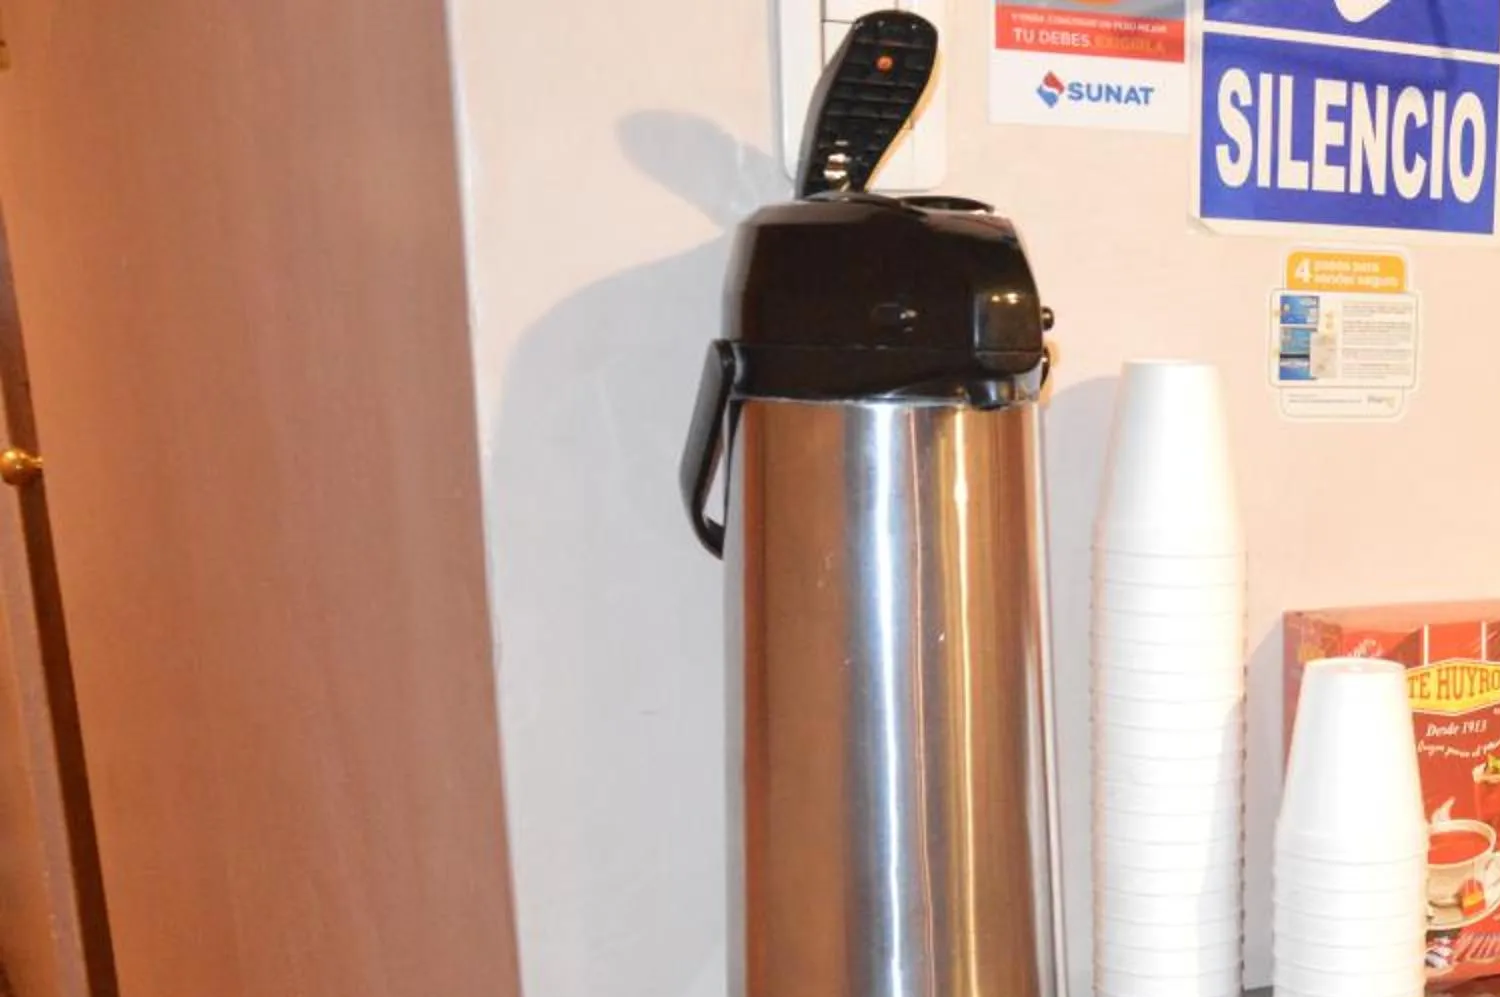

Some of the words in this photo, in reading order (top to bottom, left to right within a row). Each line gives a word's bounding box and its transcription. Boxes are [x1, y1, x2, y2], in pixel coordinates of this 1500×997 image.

[1038, 30, 1091, 48] DEBES
[1067, 81, 1155, 105] SUNAT
[1215, 67, 1487, 203] SILENCIO
[1294, 257, 1312, 284] 4
[1408, 671, 1431, 699] TE
